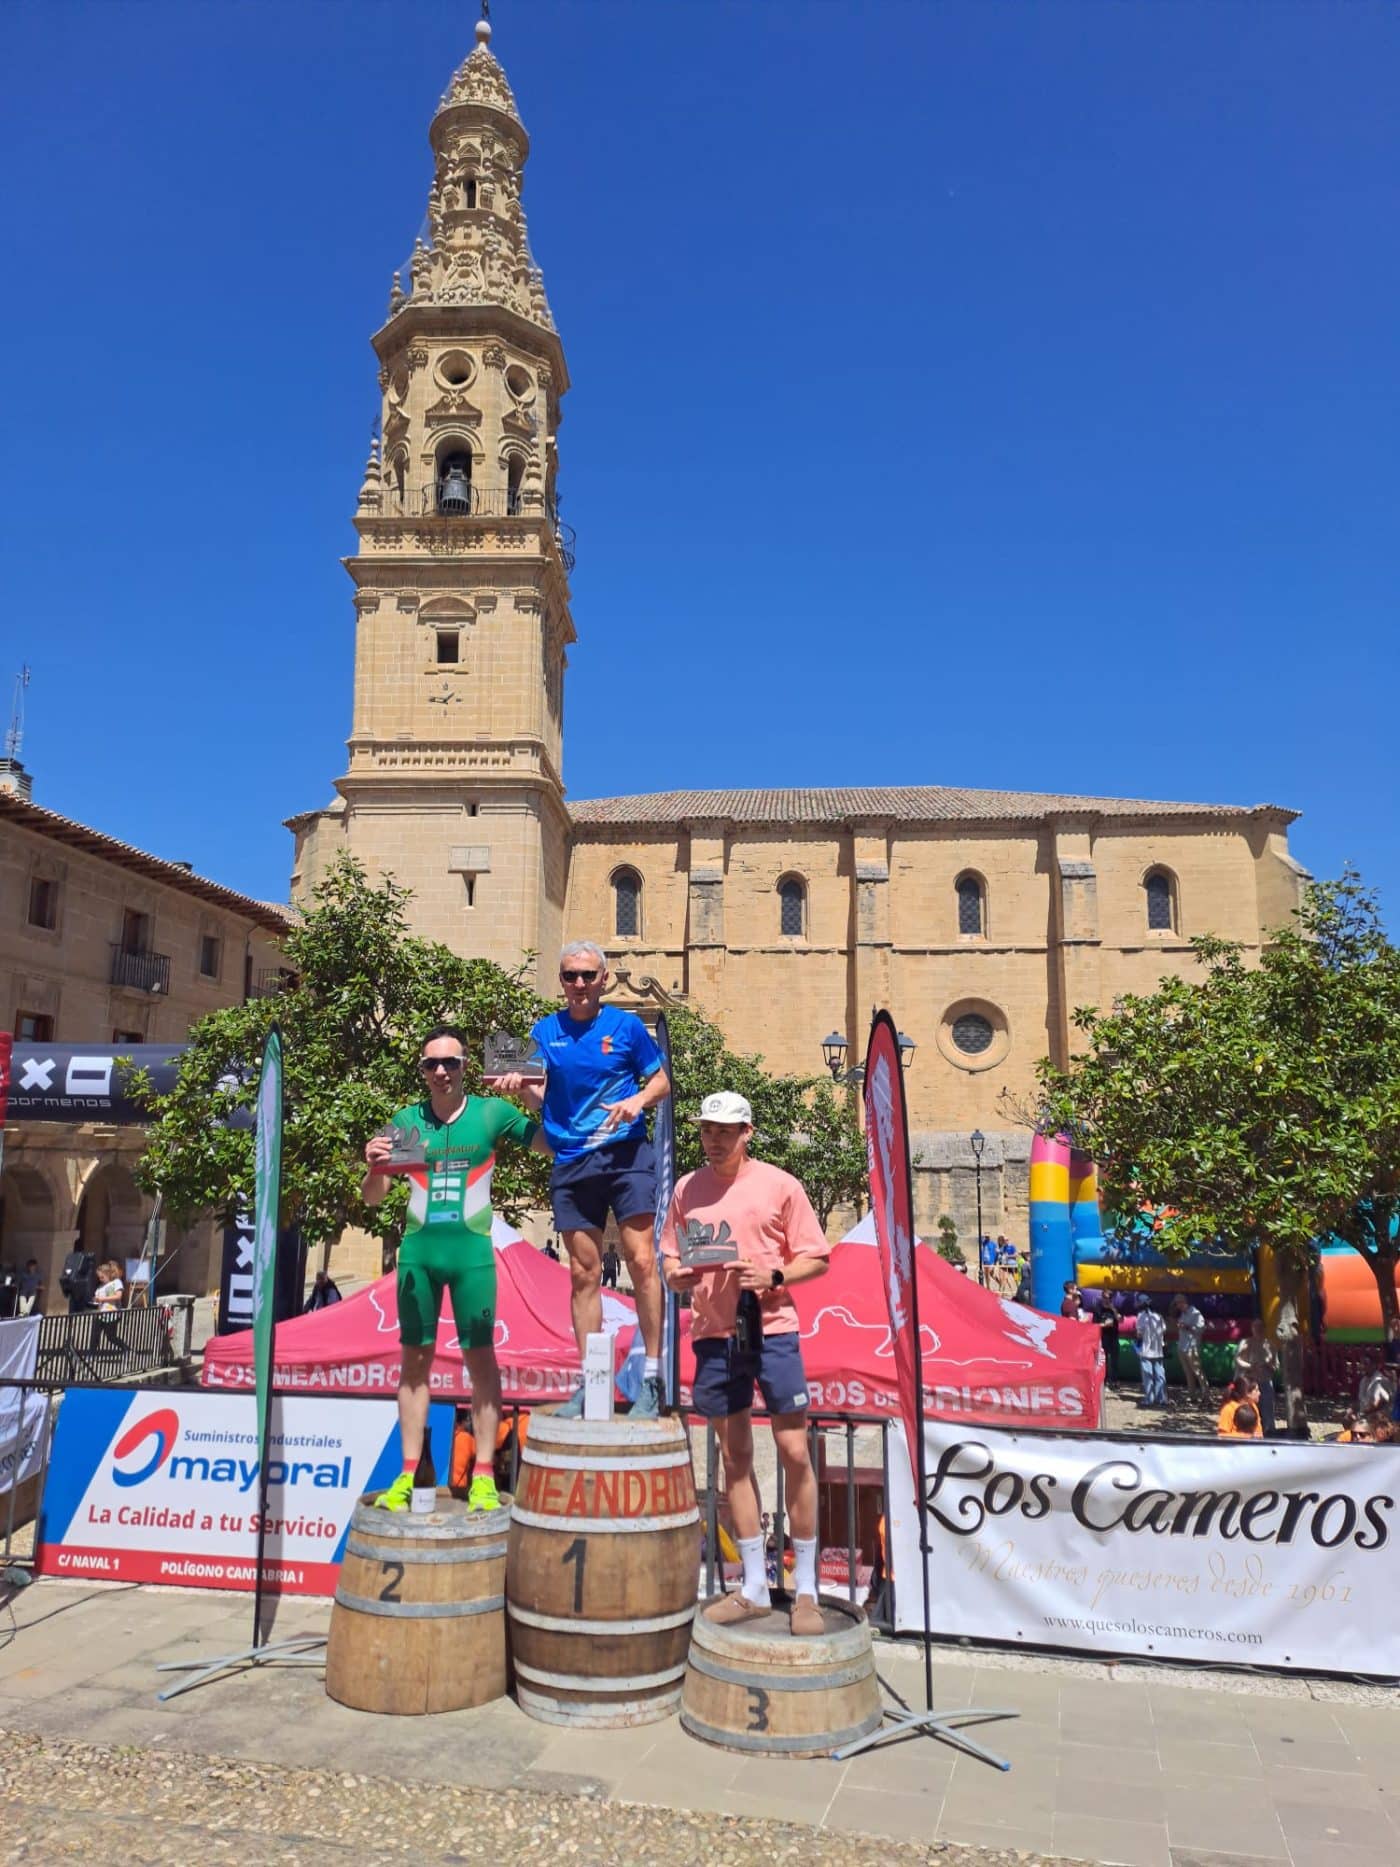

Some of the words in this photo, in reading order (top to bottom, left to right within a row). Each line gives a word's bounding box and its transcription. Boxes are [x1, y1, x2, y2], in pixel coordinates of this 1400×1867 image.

[271, 1363, 402, 1388] MEANDRO
[430, 1373, 454, 1389] DE
[184, 1429, 259, 1445] Suministros
[270, 1432, 343, 1449] ndustriales
[169, 1456, 352, 1492] mayoral
[926, 1441, 1057, 1536] Los
[1071, 1460, 1394, 1550] Cameros
[88, 1504, 111, 1524] La
[117, 1506, 196, 1530] Calidad
[201, 1514, 213, 1531] a
[219, 1513, 242, 1532] tu
[248, 1513, 337, 1538] Servicio
[72, 1555, 111, 1570] NAVAL
[113, 1558, 120, 1570] 1
[160, 1559, 224, 1578] POLÍGONO
[226, 1567, 297, 1583] CANTABRIA
[379, 1561, 404, 1602] 2
[561, 1539, 587, 1614] 1
[1208, 1551, 1273, 1598] desde
[1287, 1570, 1353, 1609] 1961
[1042, 1615, 1264, 1645] www.quesoloscameros.com
[746, 1686, 770, 1732] 3
